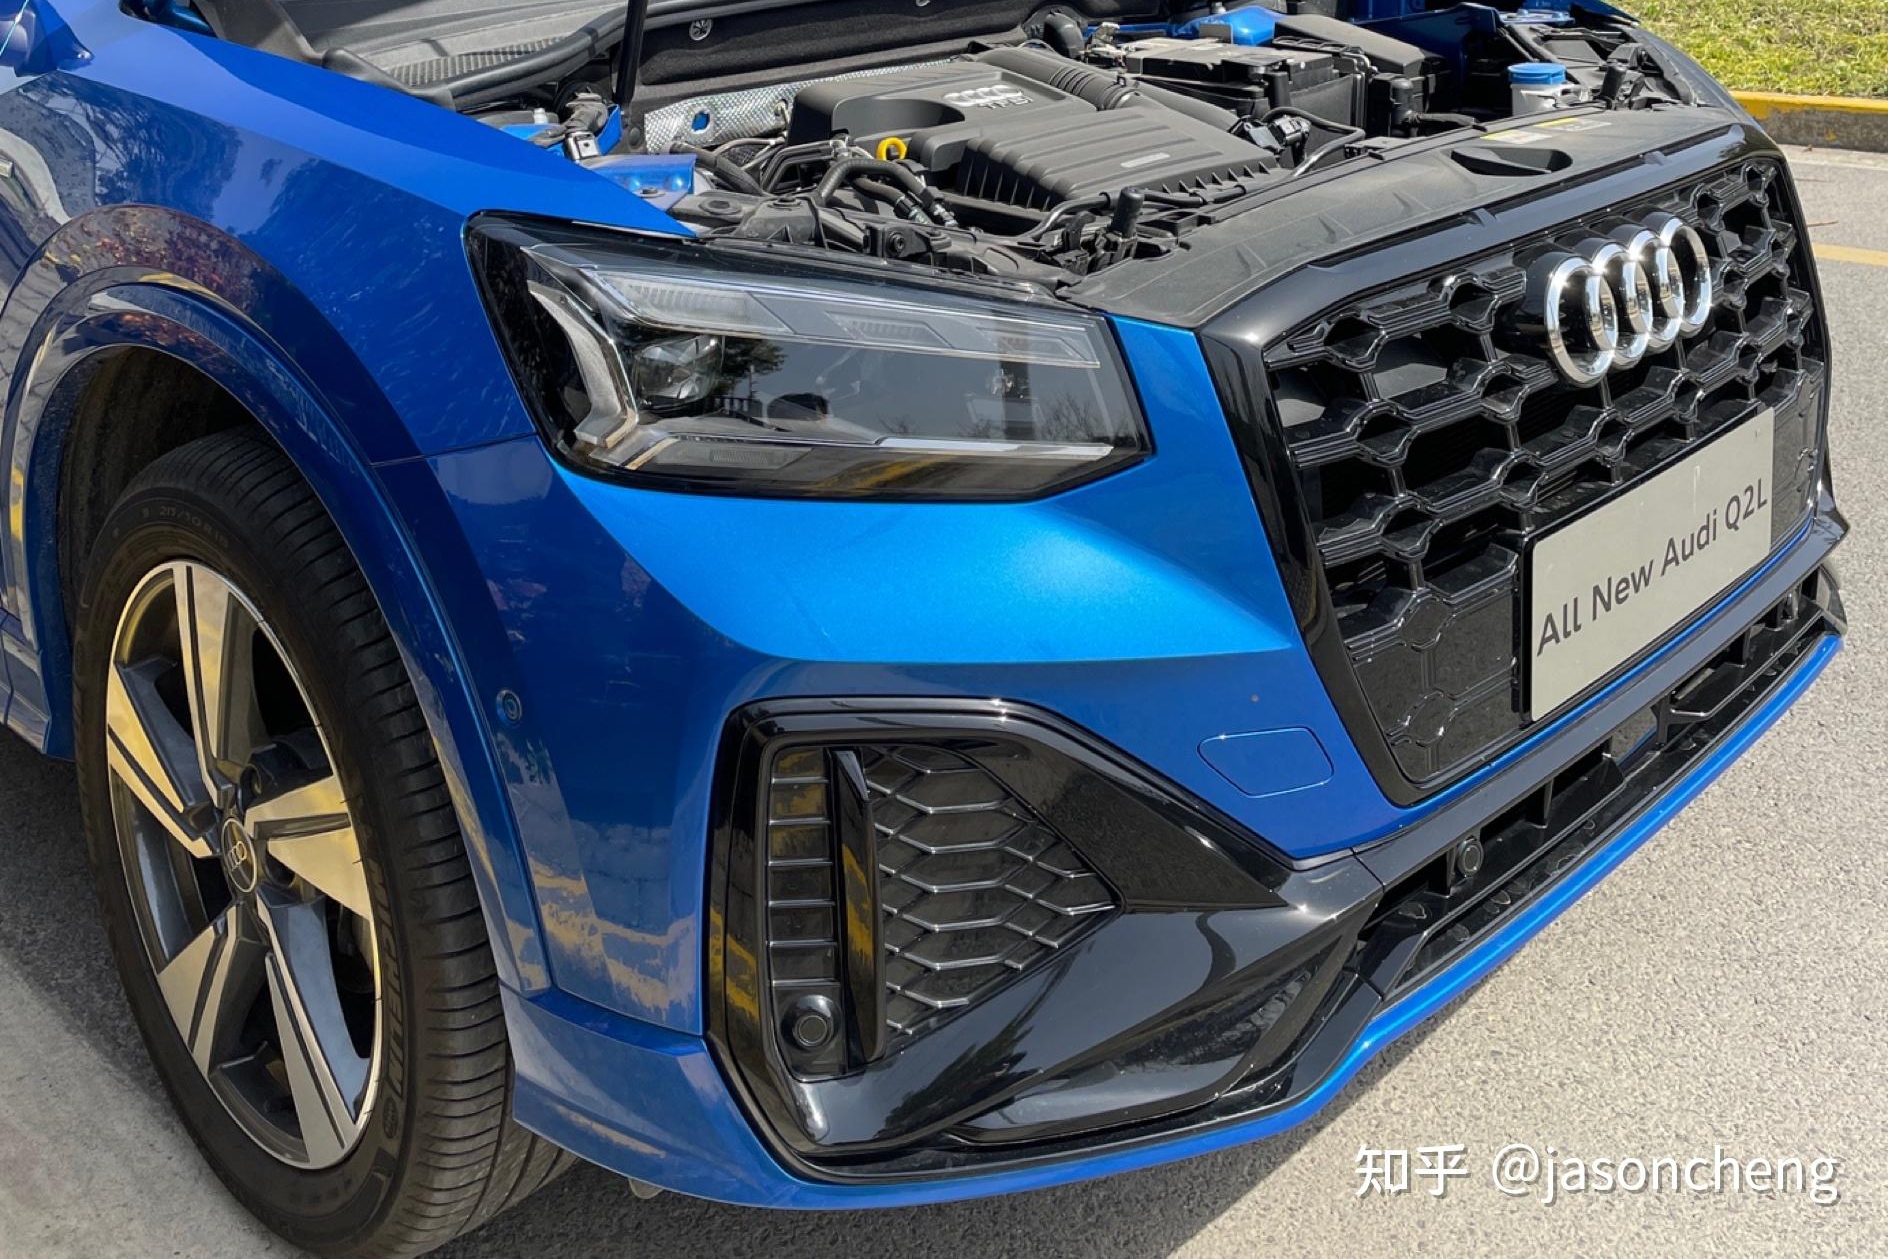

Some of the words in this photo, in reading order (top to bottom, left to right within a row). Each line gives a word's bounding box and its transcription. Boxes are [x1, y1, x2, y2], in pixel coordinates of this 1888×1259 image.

[1537, 597, 1582, 656] All
[1592, 558, 1654, 621] New
[1660, 509, 1718, 577] Audi
[1724, 478, 1767, 531] Q2L
[367, 856, 405, 1099] MICHELIN
